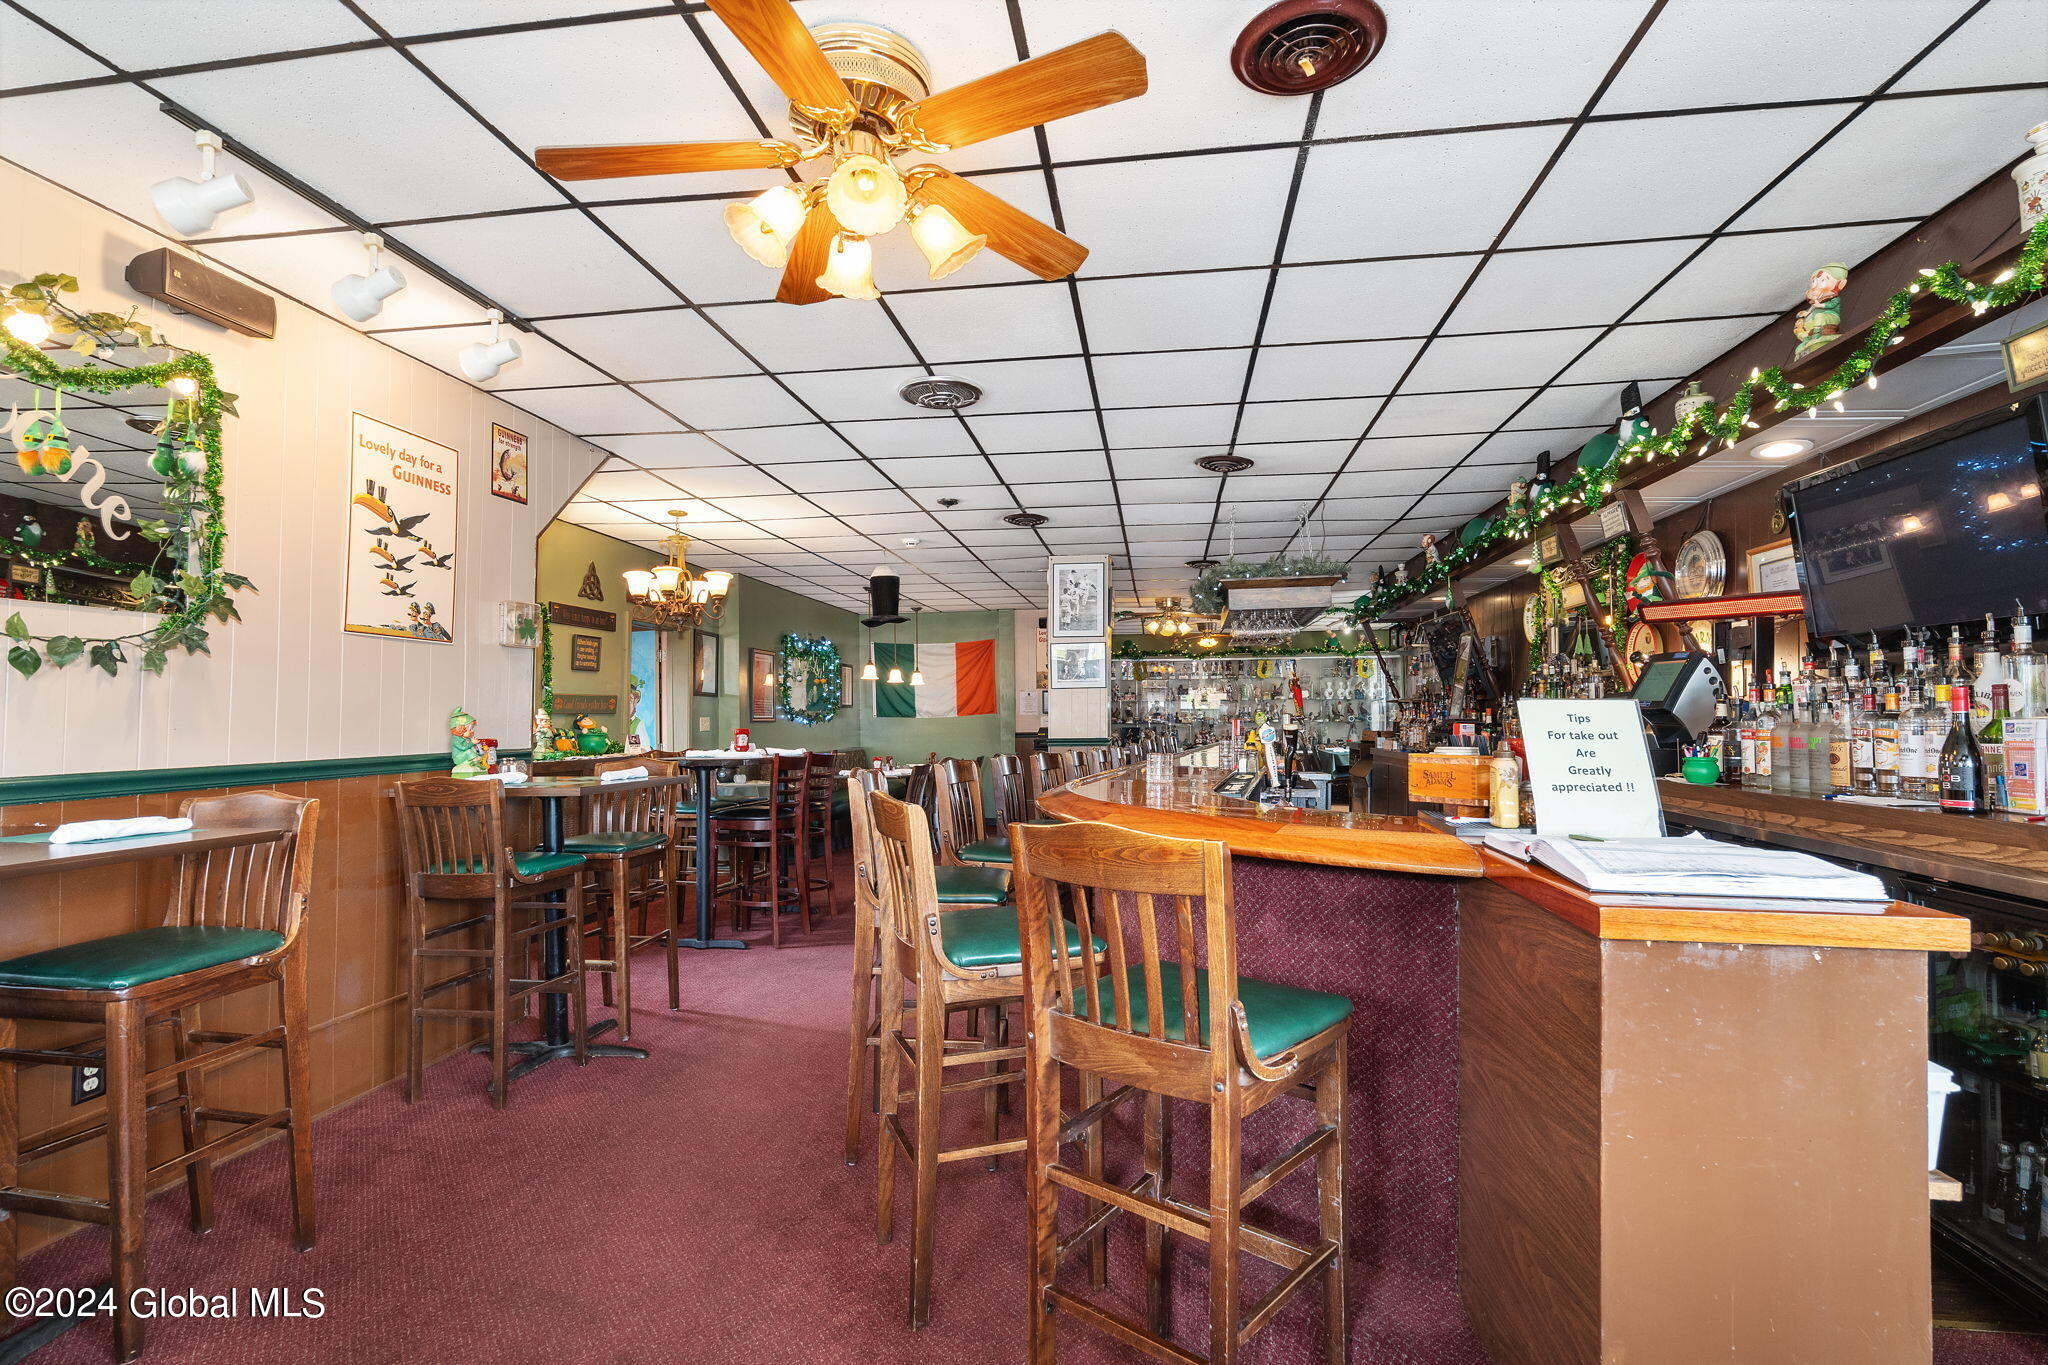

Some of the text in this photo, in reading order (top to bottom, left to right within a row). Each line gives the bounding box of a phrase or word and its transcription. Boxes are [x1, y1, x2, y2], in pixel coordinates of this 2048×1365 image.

[497, 428, 523, 445] GUINNESS
[358, 433, 443, 474] Lovely day for a
[392, 464, 452, 496] GUINNESS
[1567, 713, 1591, 725] Tips
[1547, 730, 1619, 740] For take out
[1576, 748, 1596, 758] Are
[1423, 769, 1457, 781] SAMUEL
[1568, 765, 1612, 777] Greatly
[1426, 779, 1453, 788] ADAMS
[1551, 782, 1635, 794] appreciated !!
